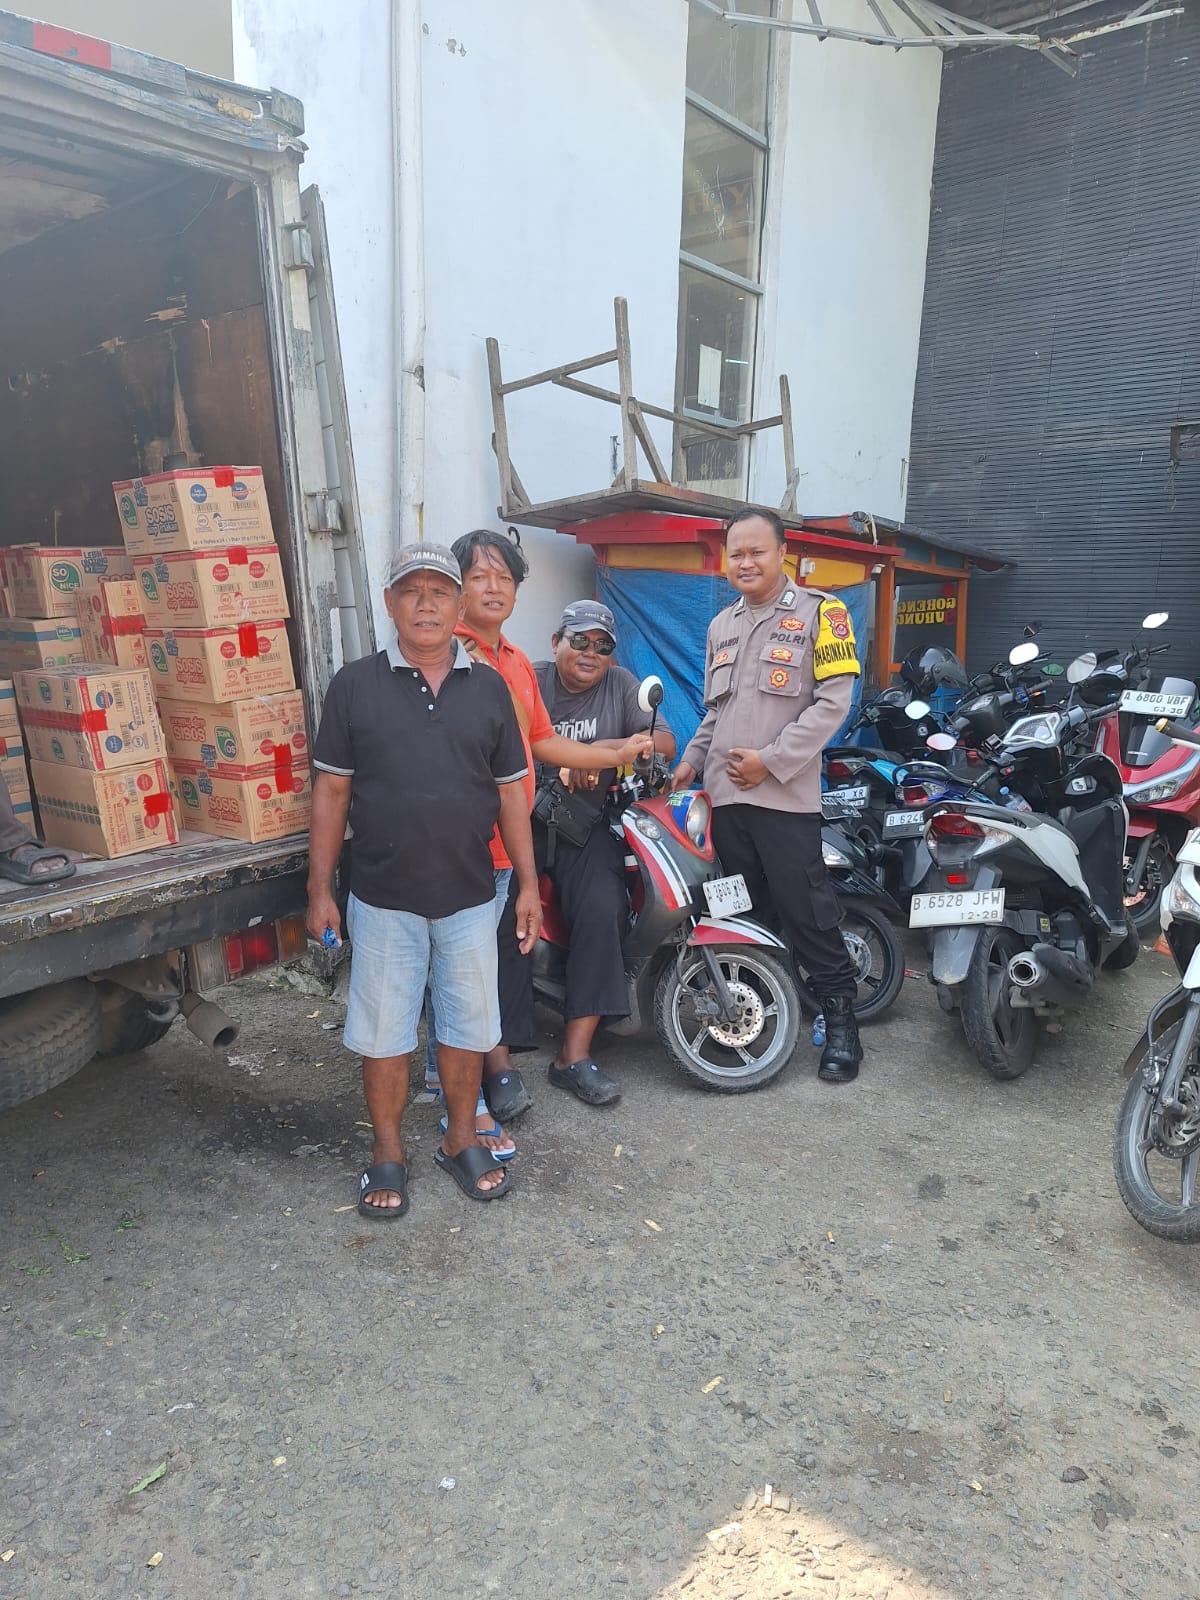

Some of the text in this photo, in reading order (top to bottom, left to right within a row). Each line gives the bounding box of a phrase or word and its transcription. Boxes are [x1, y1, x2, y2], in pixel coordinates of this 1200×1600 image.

[145, 503, 175, 524] SOSIS
[412, 551, 447, 566] YAMAHA
[52, 568, 68, 577] SO
[166, 582, 196, 600] SOSIS
[769, 632, 806, 645] POLRI
[176, 657, 204, 674] SOSIS
[1123, 692, 1188, 706] A 6800 VBF
[852, 788, 864, 798] XR
[208, 795, 240, 813] SOSIS
[889, 815, 895, 826] B
[928, 894, 963, 909] 6528
[973, 891, 1000, 906] JFW
